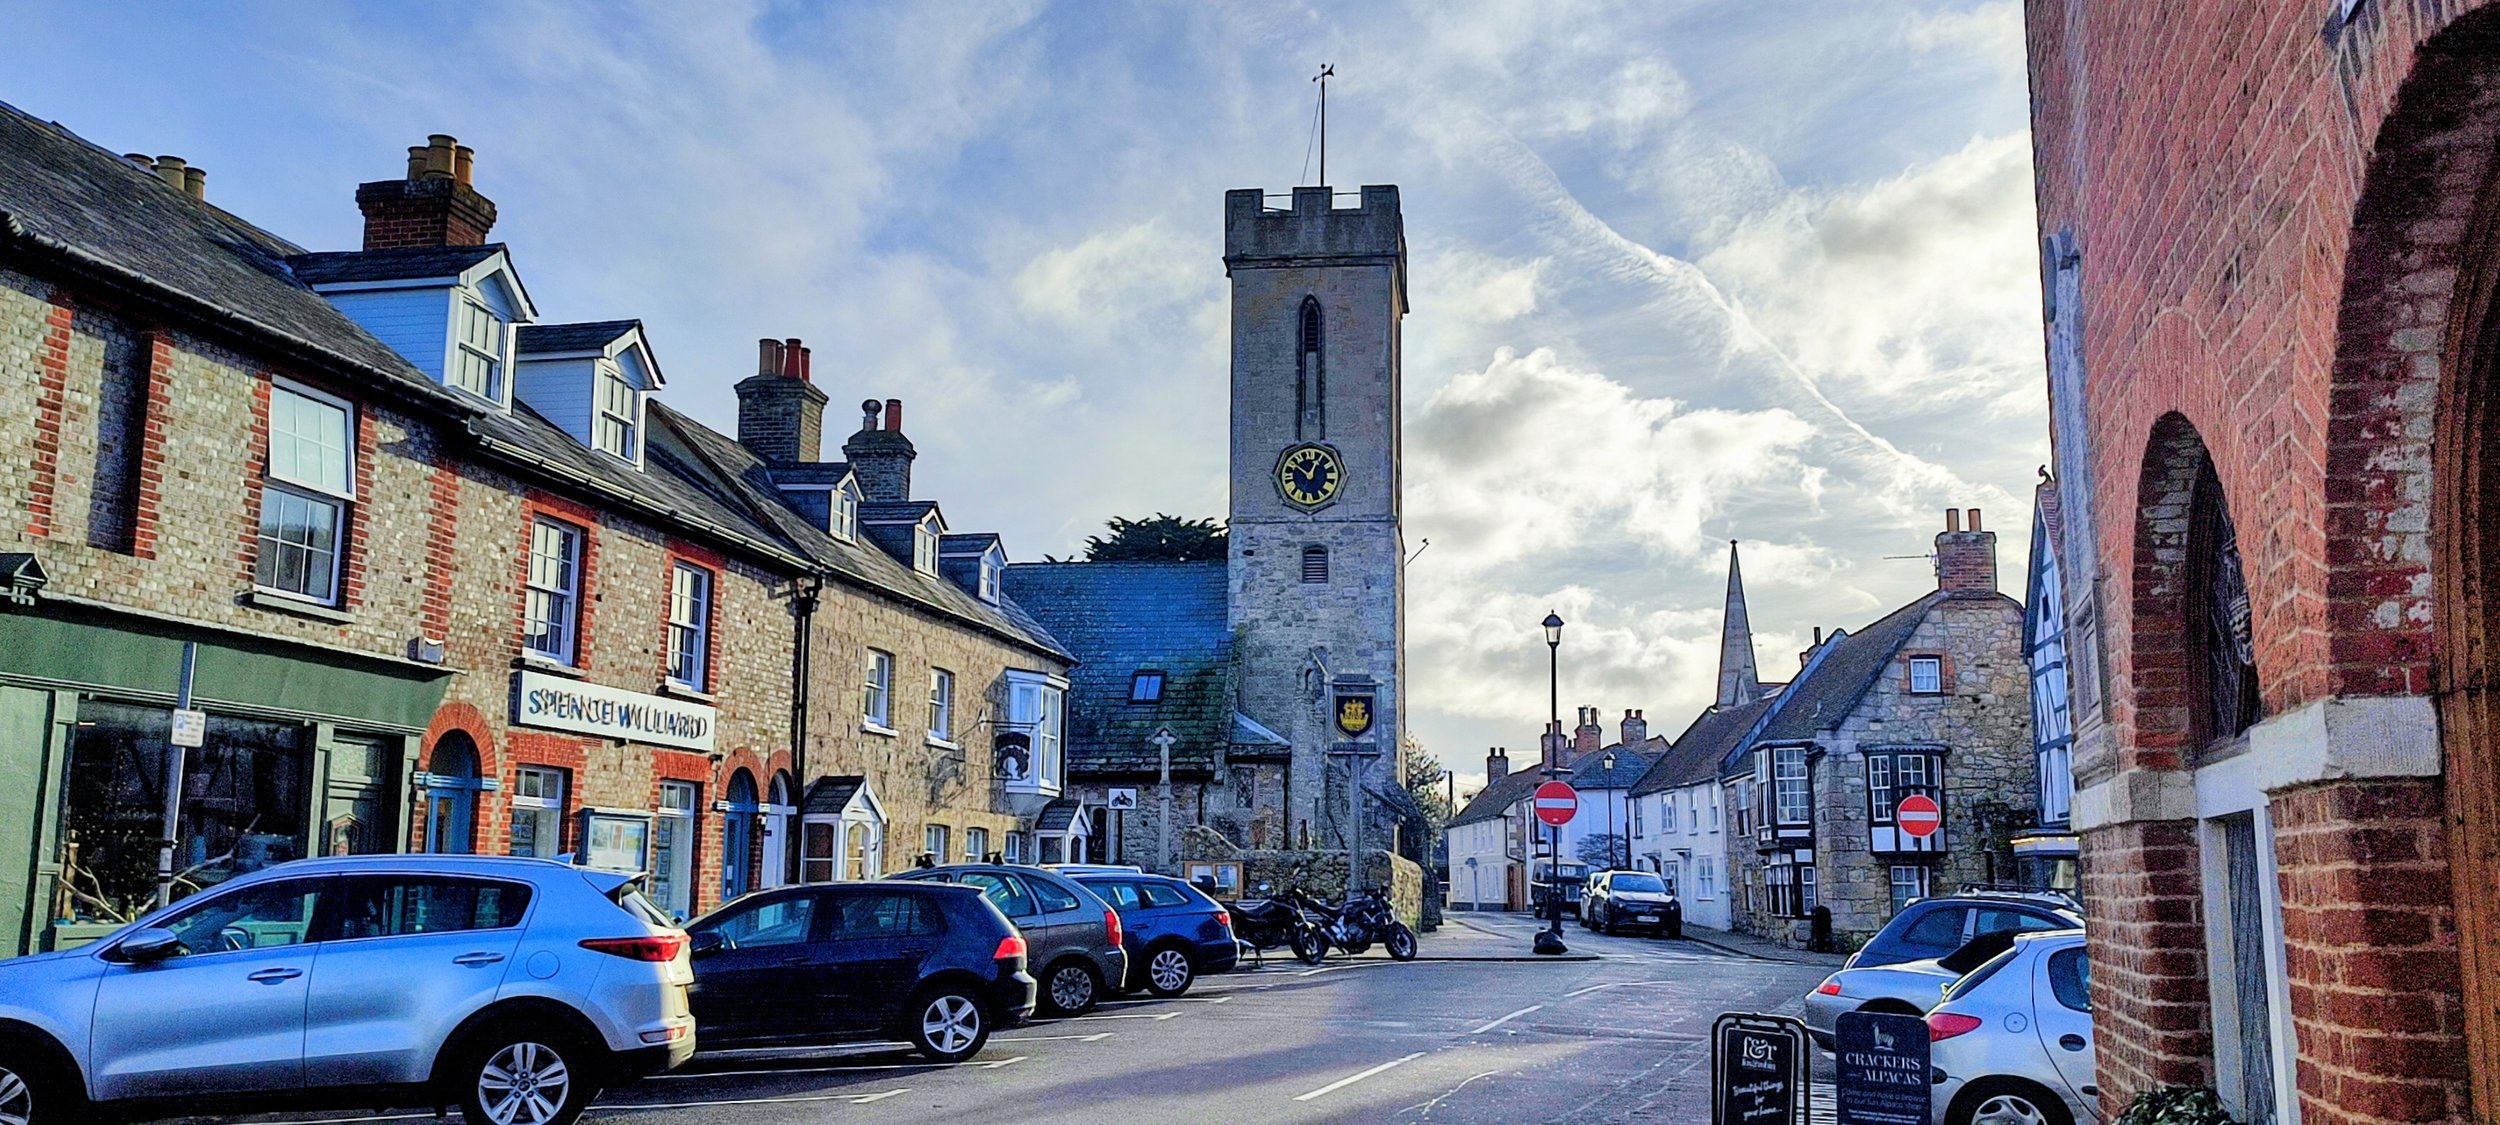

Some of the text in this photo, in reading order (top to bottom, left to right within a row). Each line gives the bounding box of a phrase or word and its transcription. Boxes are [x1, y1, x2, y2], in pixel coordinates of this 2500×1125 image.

[528, 689, 707, 740] SPENCE WILLARD
[1742, 1036, 1778, 1060] f&r
[1845, 1052, 1921, 1070] CRACKERS
[1863, 1069, 1921, 1085] ALPACAS
